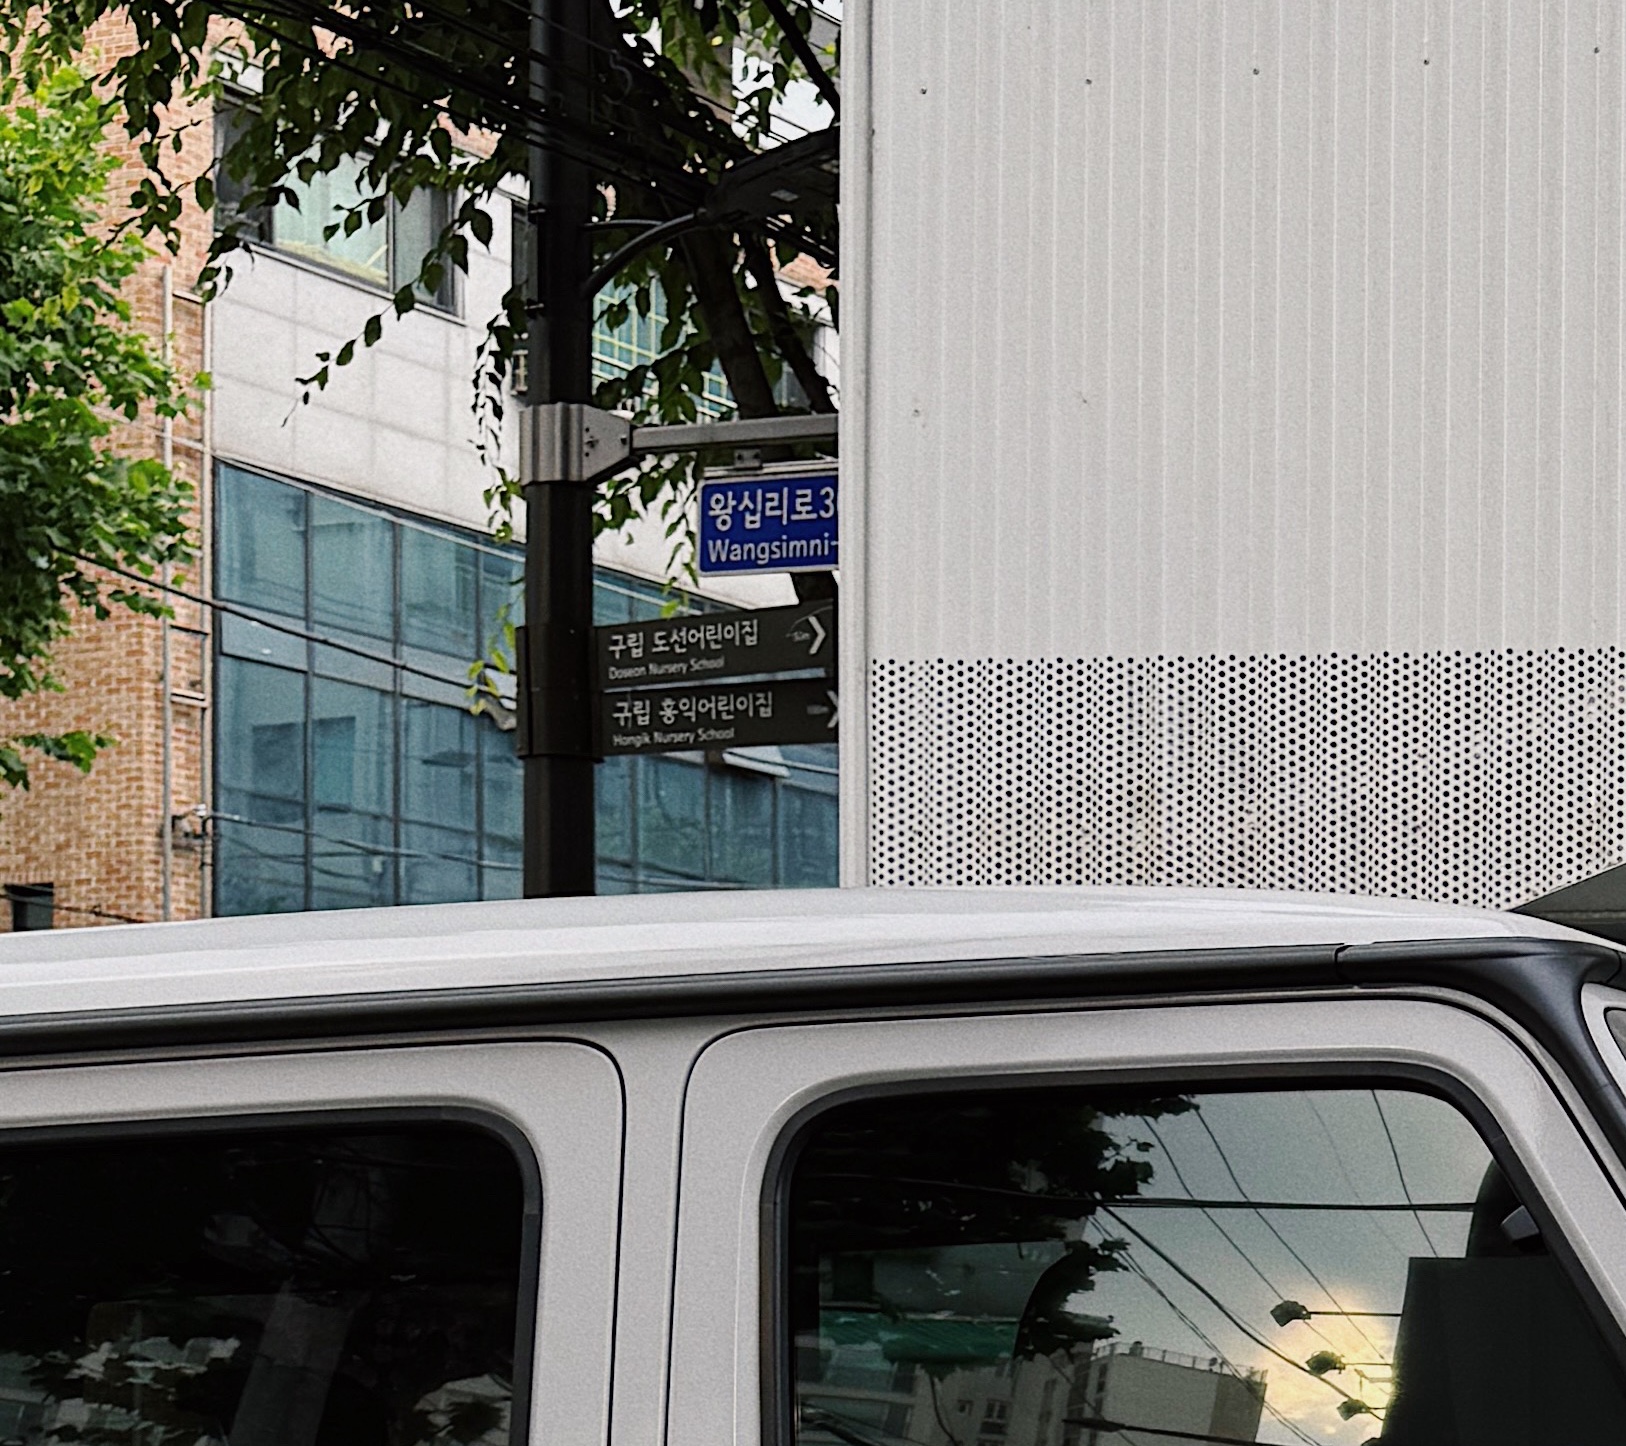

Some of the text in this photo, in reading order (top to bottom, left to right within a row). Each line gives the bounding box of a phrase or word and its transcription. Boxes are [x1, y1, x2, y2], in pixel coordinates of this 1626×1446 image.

[708, 486, 838, 532] 왕십리로3
[707, 532, 838, 565] Wangsimni-
[608, 618, 759, 660] 구립 도선어린이집
[608, 655, 726, 680] Doseon Nursery School
[612, 691, 773, 727] 구립 홍익어린이집
[612, 727, 735, 748] Hongik Nursery School
